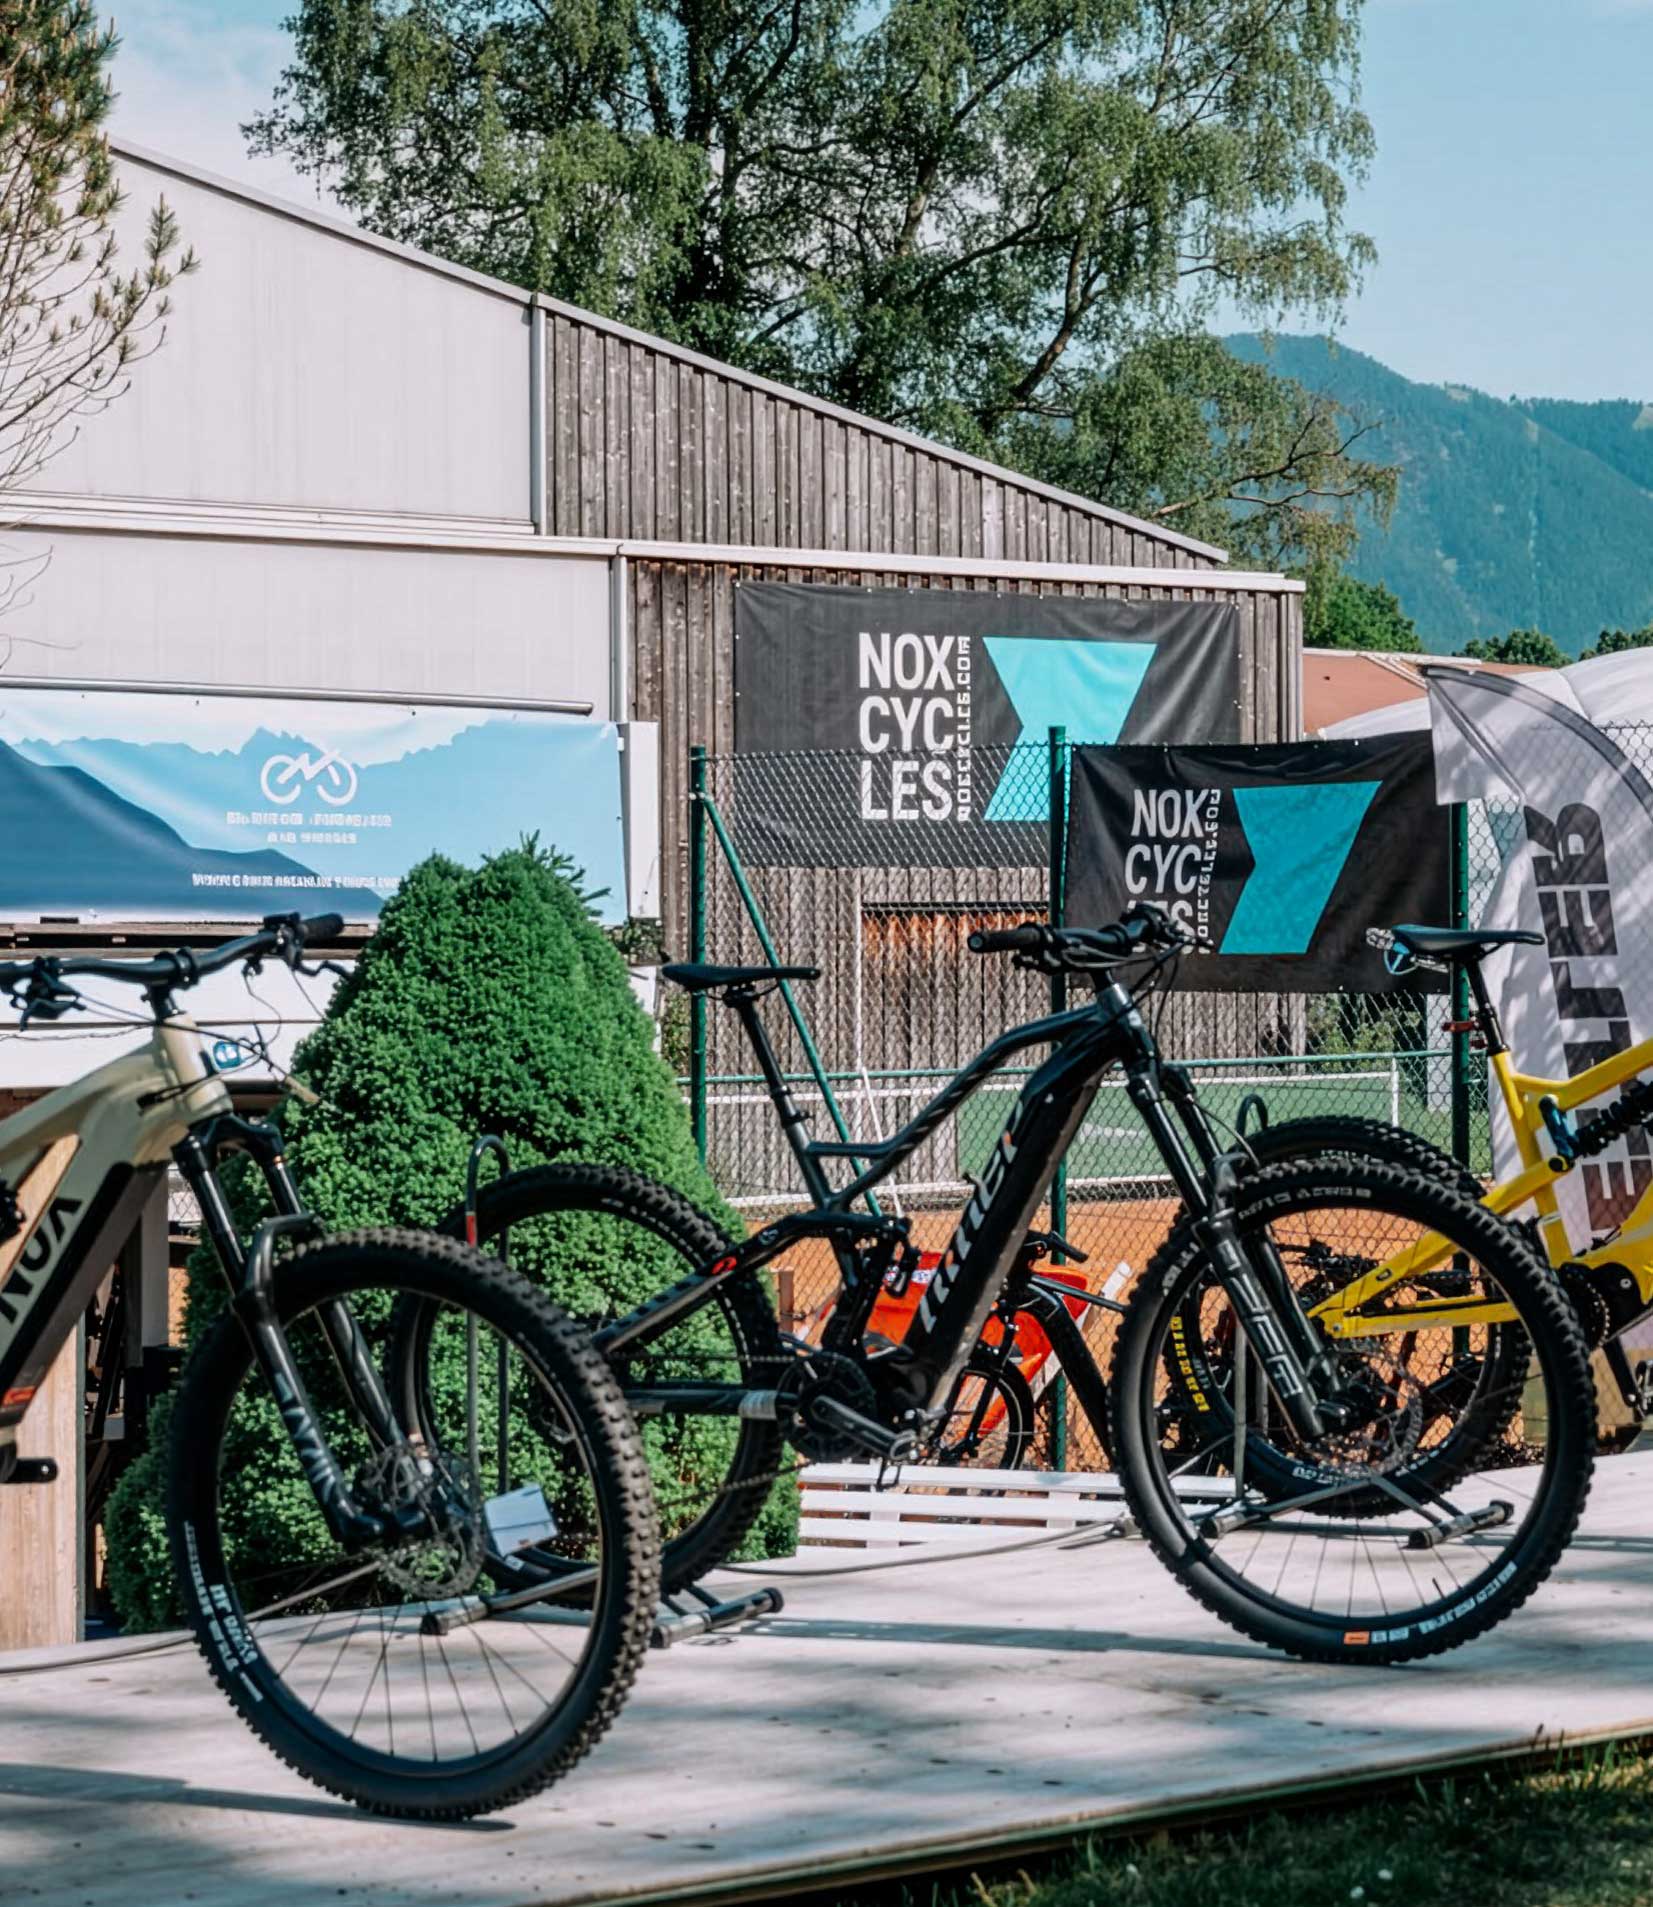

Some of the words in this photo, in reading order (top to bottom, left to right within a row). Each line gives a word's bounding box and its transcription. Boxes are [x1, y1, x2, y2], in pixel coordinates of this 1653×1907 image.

[858, 631, 956, 691] NOX
[859, 695, 954, 754] CYC
[861, 759, 953, 821] LES
[1130, 788, 1209, 838] NOX
[1125, 843, 1201, 895] CYC
